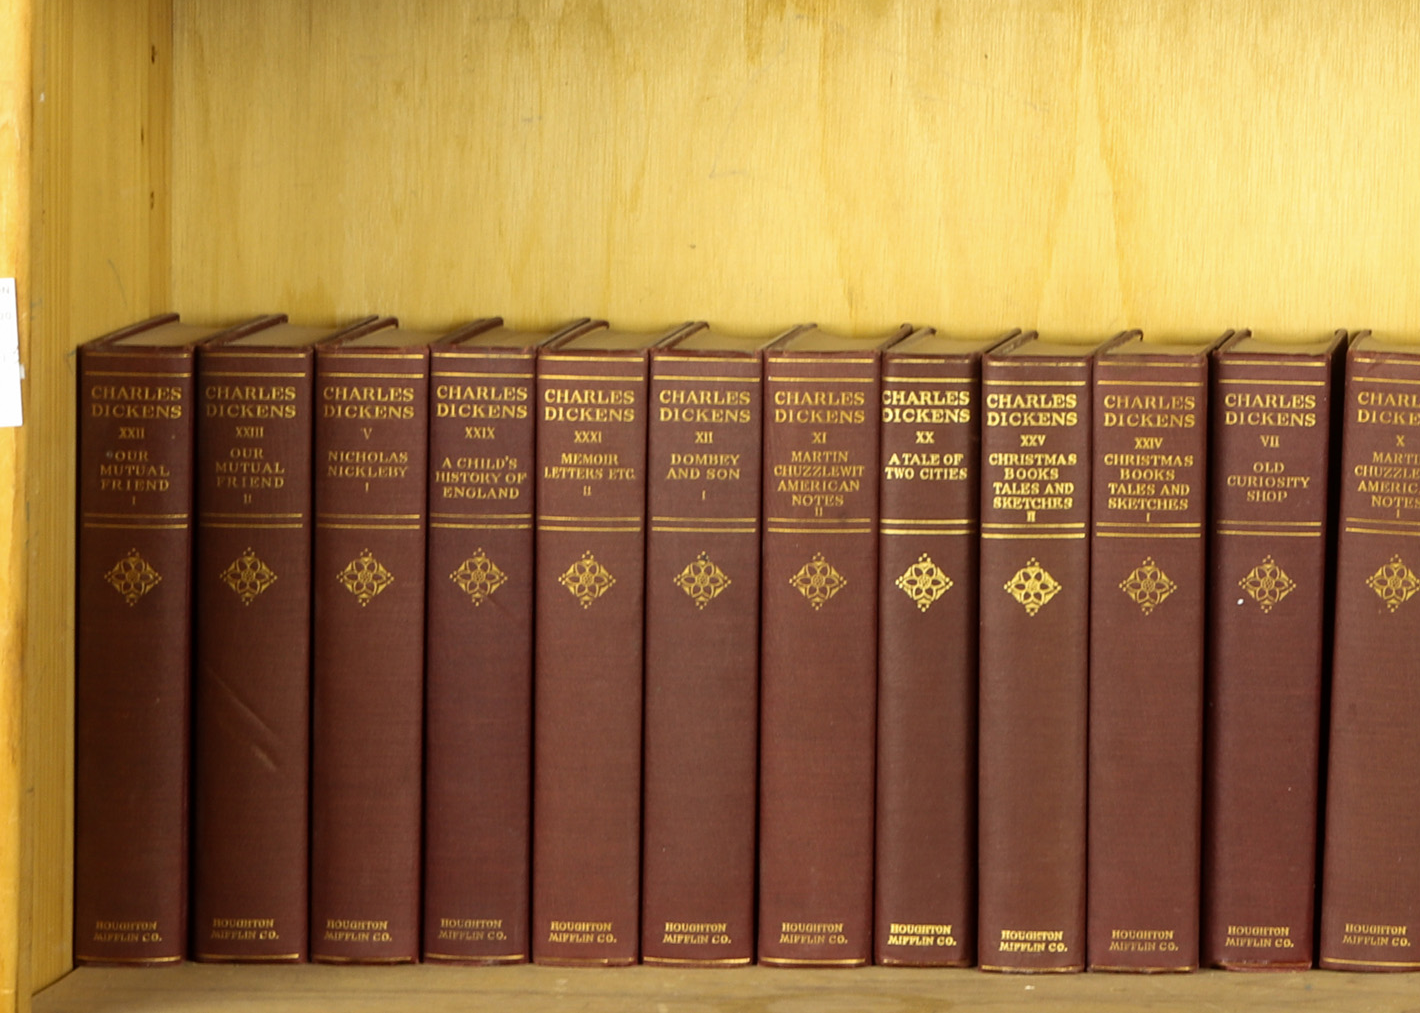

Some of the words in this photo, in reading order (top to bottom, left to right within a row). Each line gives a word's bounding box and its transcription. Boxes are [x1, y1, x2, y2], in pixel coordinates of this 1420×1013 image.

[206, 386, 296, 401] CHARLES
[544, 388, 635, 406] CHARLES
[884, 390, 970, 406] CHARLES
[1104, 394, 1195, 411] CHARLES
[207, 404, 296, 419] DICKENS
[544, 406, 635, 423] DICKENS
[884, 407, 970, 423] DICKENS
[1103, 412, 1195, 429] DICKENS
[465, 426, 495, 439] XXIX
[915, 431, 935, 444] XX
[1260, 435, 1280, 448] VII
[115, 450, 148, 461] OUR
[328, 450, 408, 465] NICHOLAS
[442, 457, 454, 470] A
[457, 454, 517, 471] CHILD'S
[670, 452, 740, 467] DOMBEY
[791, 451, 849, 463] MARTIN
[888, 453, 900, 466] A
[902, 453, 940, 466] TALE
[943, 453, 964, 466] OF
[988, 453, 1077, 466] CHRISTMAS
[101, 464, 170, 477] MUTUAL
[328, 464, 409, 479] NICKLEBY
[665, 467, 700, 480] AND
[706, 468, 740, 481] SON
[774, 464, 865, 477] CHUZZLEWIT
[884, 467, 916, 480] TWO
[919, 467, 967, 480] CITIES
[1004, 467, 1059, 480] BOOKS
[1253, 461, 1284, 473] OLD
[436, 470, 499, 485] HISTORY
[505, 470, 527, 485] OF
[1227, 474, 1310, 489] CURIOSITY
[101, 478, 169, 492] FRIEND
[777, 479, 860, 492] AMERICAN
[993, 482, 1039, 495] TALES
[1045, 482, 1074, 495] AND
[443, 485, 519, 500] ENGLAND
[1247, 489, 1287, 502] SHOP
[792, 494, 844, 508] NOTES
[992, 496, 1073, 510] SKETCHES
[890, 923, 951, 935] HOUGHTON
[887, 934, 934, 946] MIFFLIN
